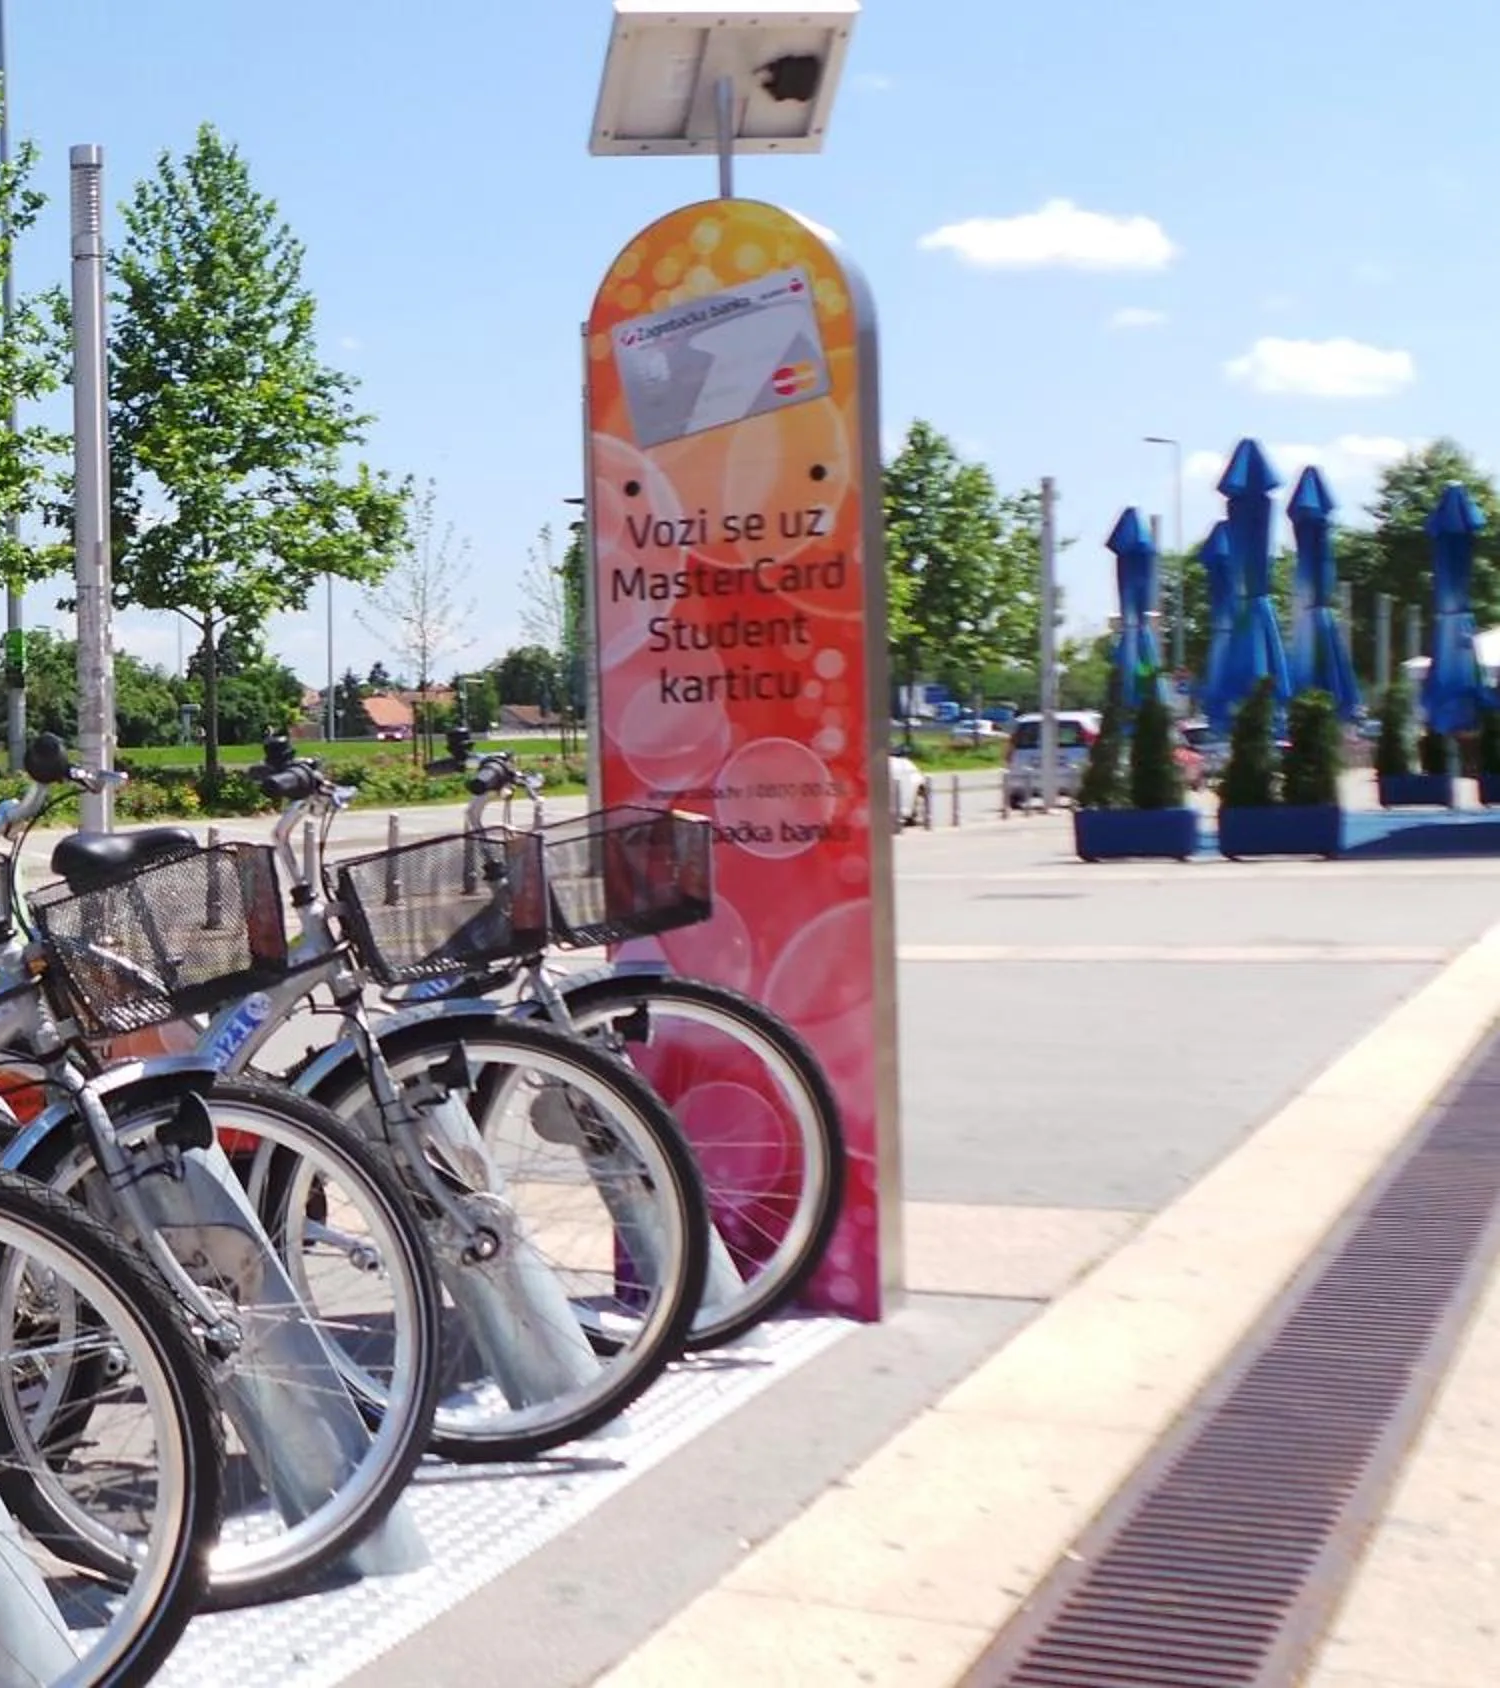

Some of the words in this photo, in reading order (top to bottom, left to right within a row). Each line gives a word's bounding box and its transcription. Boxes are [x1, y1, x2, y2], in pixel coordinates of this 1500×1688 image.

[627, 509, 708, 549] Vozi
[722, 511, 767, 543] se
[779, 508, 826, 538] uz
[611, 552, 847, 602] MasterCard
[647, 614, 810, 653] Student
[660, 668, 800, 704] karticu
